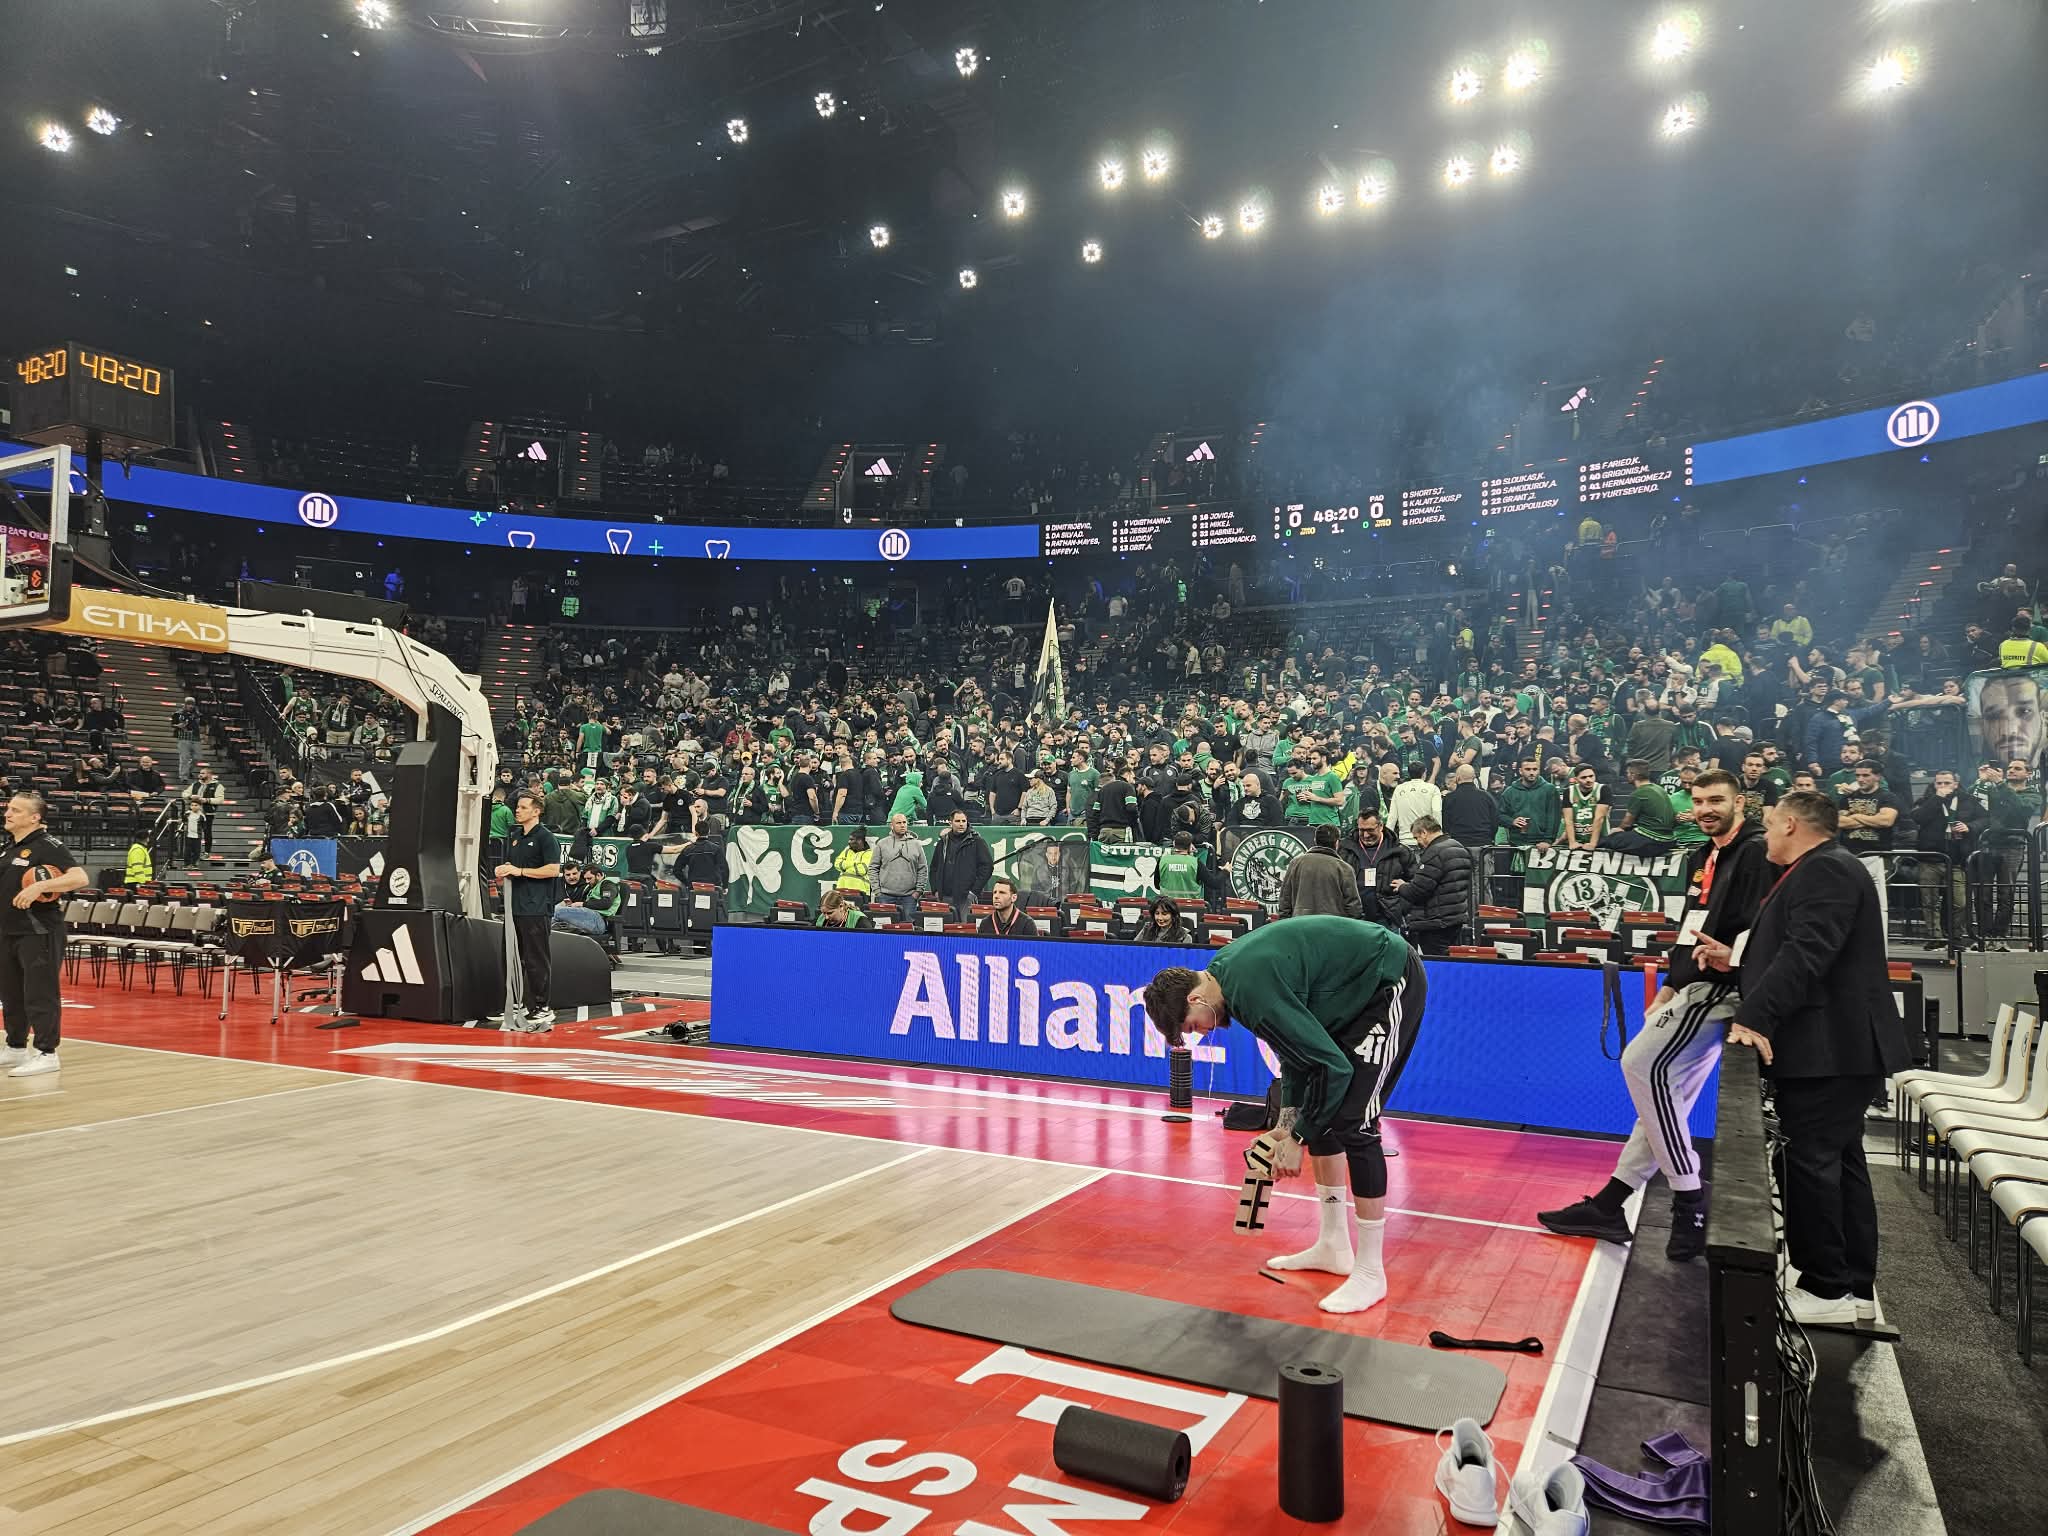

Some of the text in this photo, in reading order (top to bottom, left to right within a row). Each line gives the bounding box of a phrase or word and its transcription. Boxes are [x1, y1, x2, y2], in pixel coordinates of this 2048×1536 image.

[17, 350, 67, 384] 48:20
[80, 351, 161, 395] 48:20
[1289, 511, 1302, 527] 0
[1313, 506, 1359, 523] 48:20
[1370, 502, 1384, 519] 0
[83, 605, 225, 643] ETIHAD
[430, 684, 464, 719] SPALDING
[1576, 807, 1593, 820] 25
[290, 852, 317, 867] BMW
[1572, 878, 1595, 902] 13
